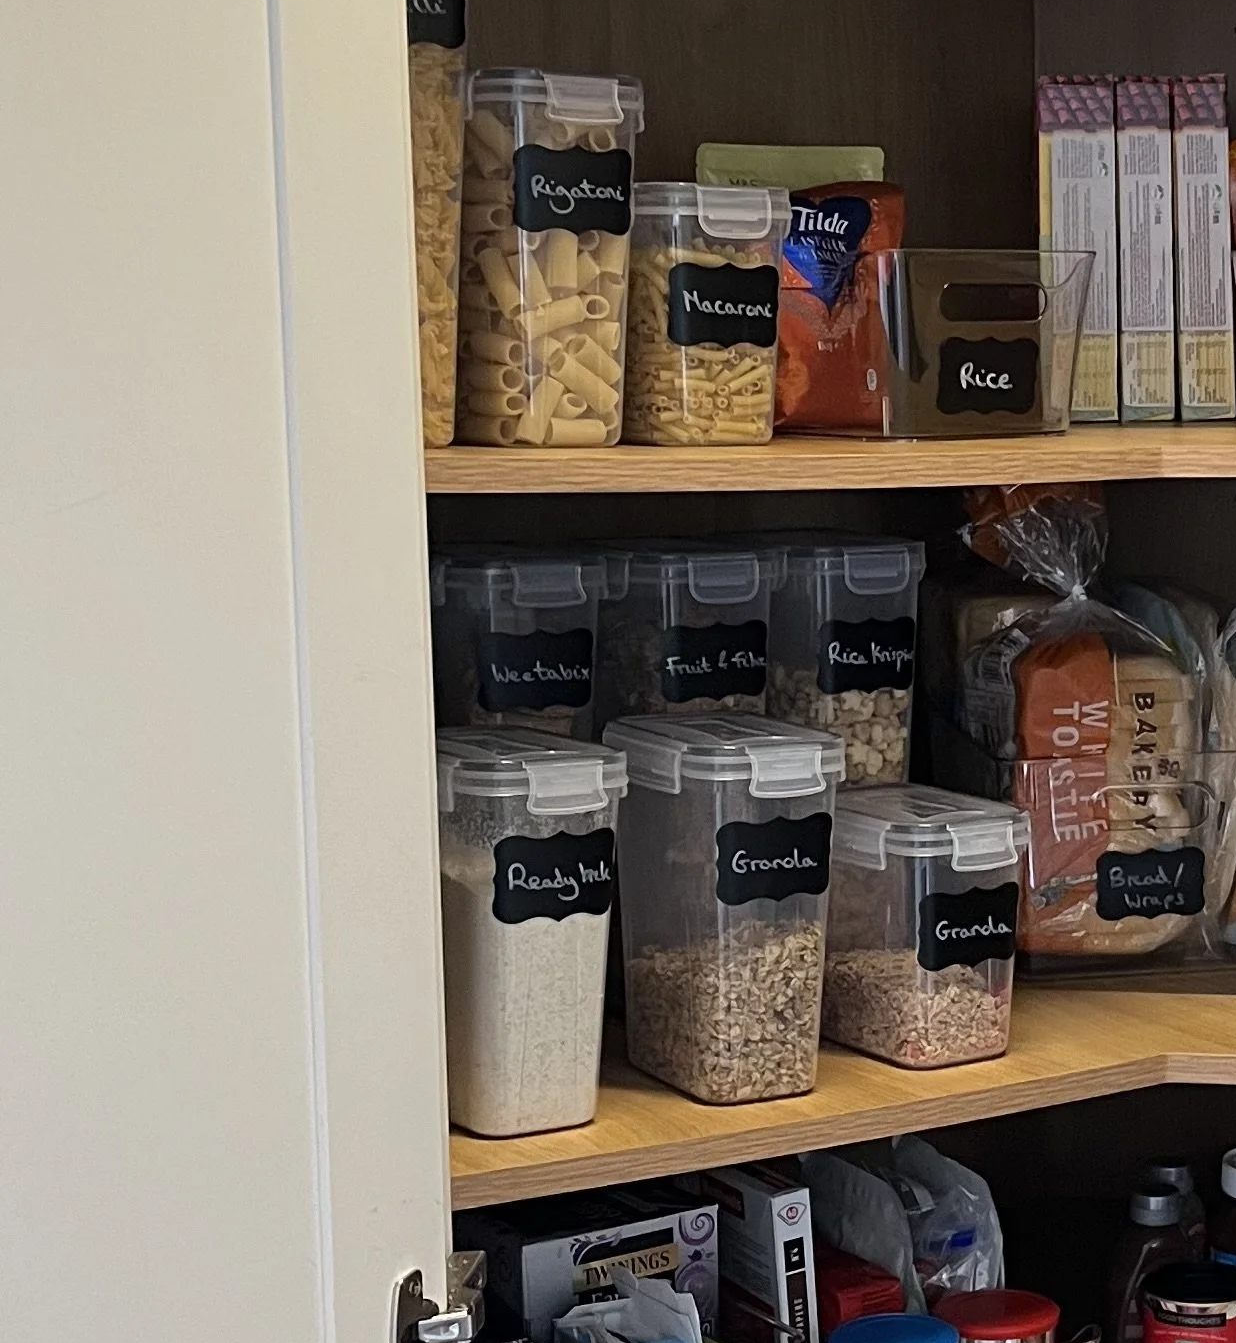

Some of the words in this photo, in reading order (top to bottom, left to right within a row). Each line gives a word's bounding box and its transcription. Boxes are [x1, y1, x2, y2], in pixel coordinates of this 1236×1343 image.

[530, 174, 625, 215] Rigatoni
[791, 206, 849, 235] Tilda
[682, 289, 774, 319] Macaroni
[959, 361, 1013, 391] Rice
[666, 656, 713, 677] Fruit
[828, 641, 868, 665] Rice
[490, 659, 591, 683] Weetabix
[1051, 700, 1081, 841] TOASTIE
[1078, 700, 1110, 840] WHITE
[1131, 692, 1158, 836] BAKERY
[731, 848, 818, 874] Granola
[507, 862, 579, 901] Ready
[1123, 892, 1185, 910] Wraps
[936, 916, 1012, 942] Granola
[583, 1250, 671, 1285] TWNINGS
